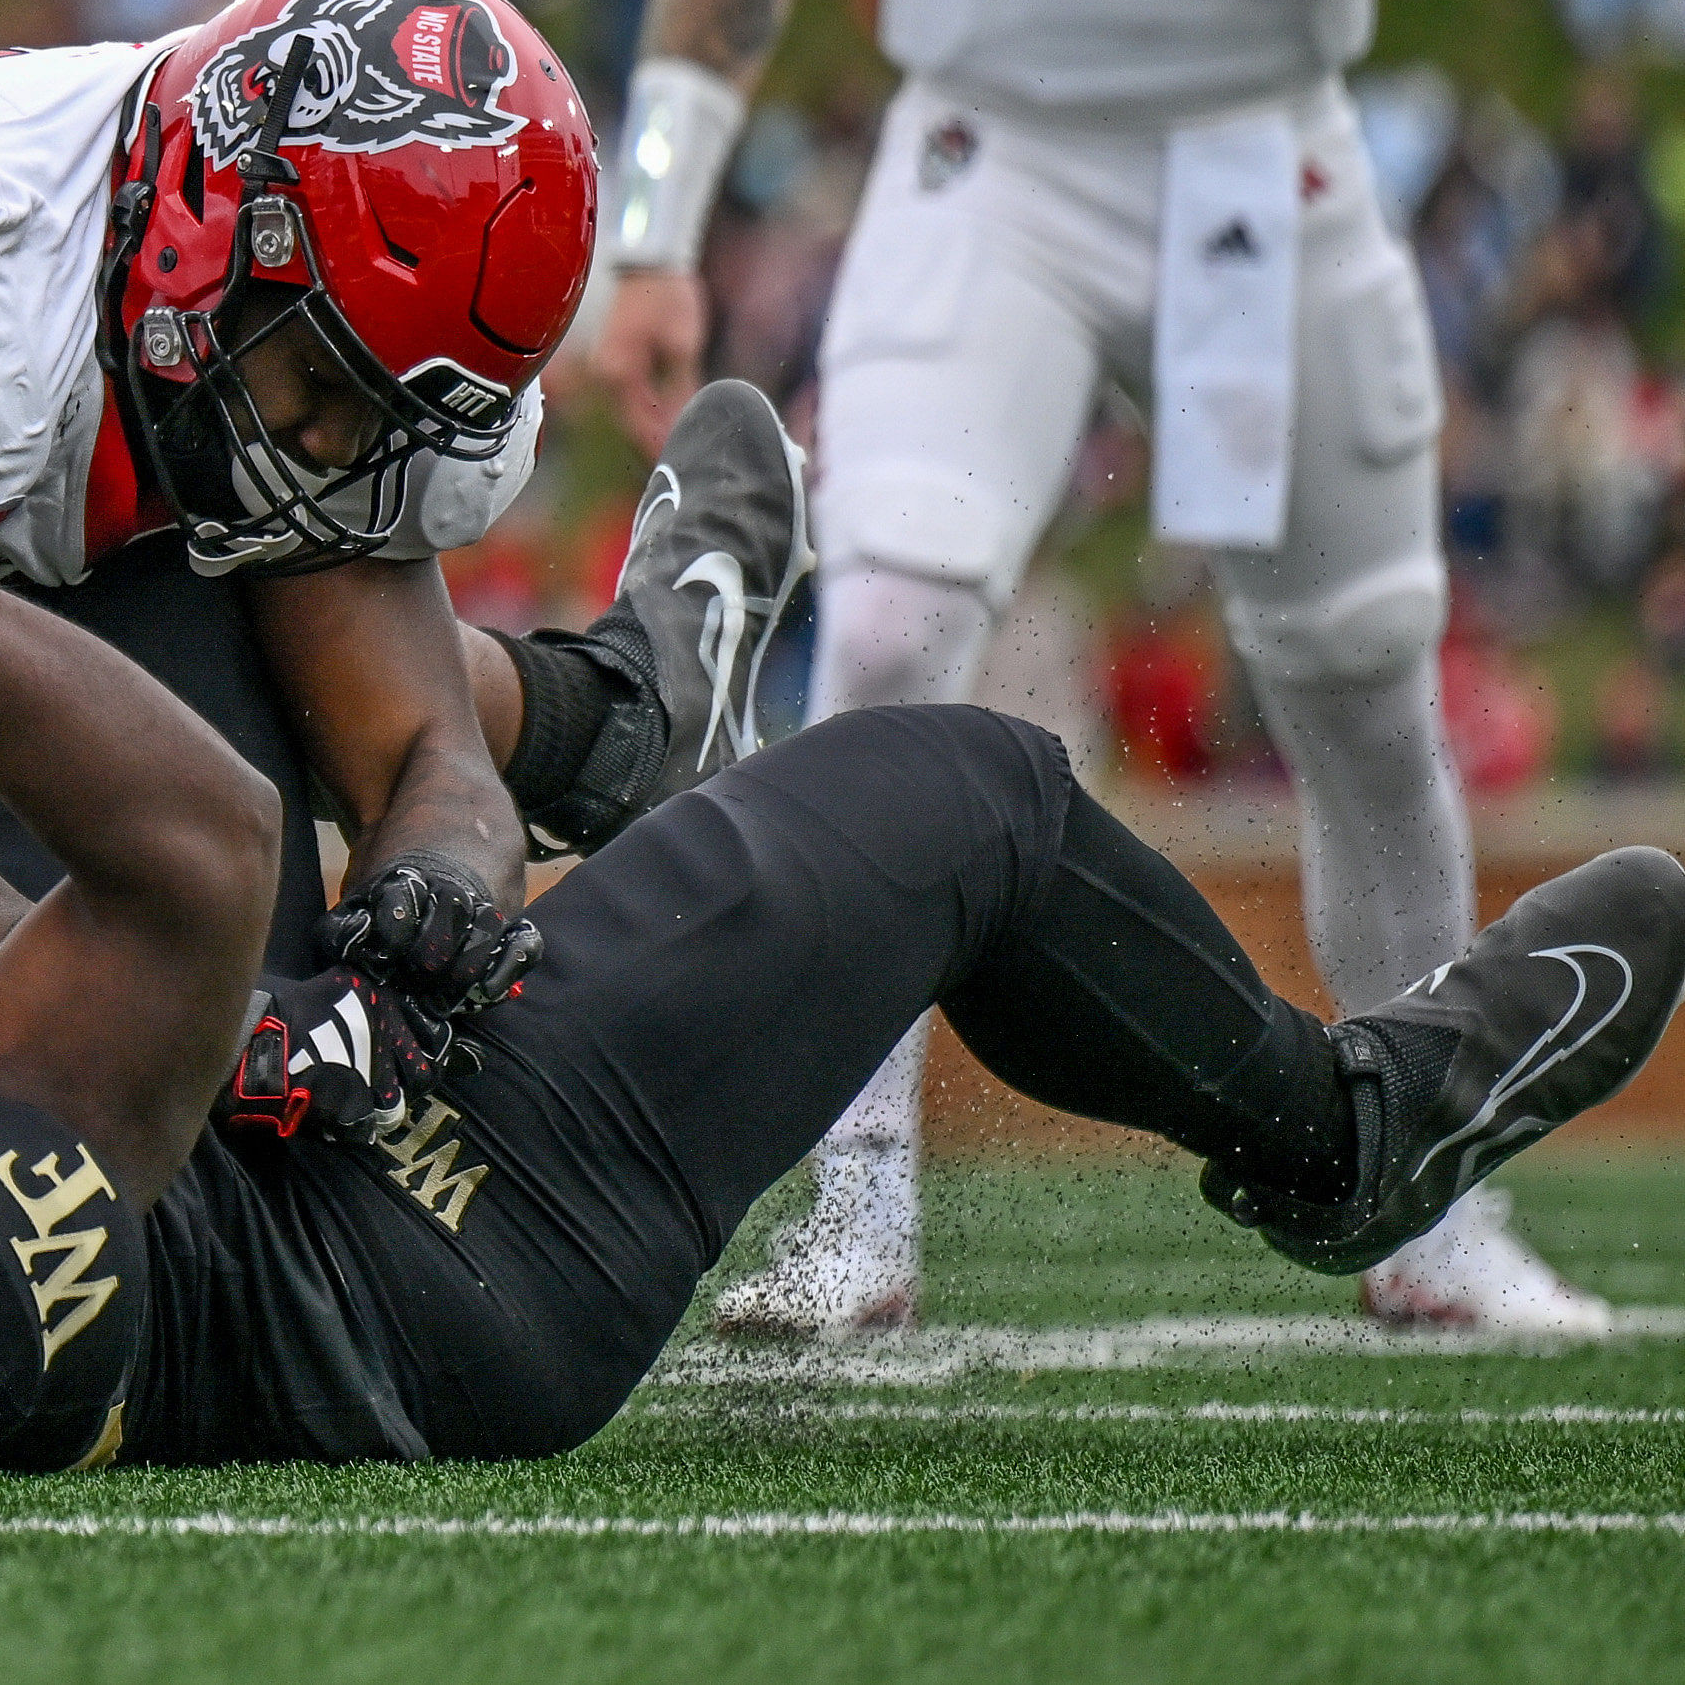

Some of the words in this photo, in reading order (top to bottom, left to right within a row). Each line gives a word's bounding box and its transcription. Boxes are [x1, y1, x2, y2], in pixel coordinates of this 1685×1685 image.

[416, 11, 449, 32] NC
[412, 33, 443, 85] STATE
[441, 381, 497, 418] HTT
